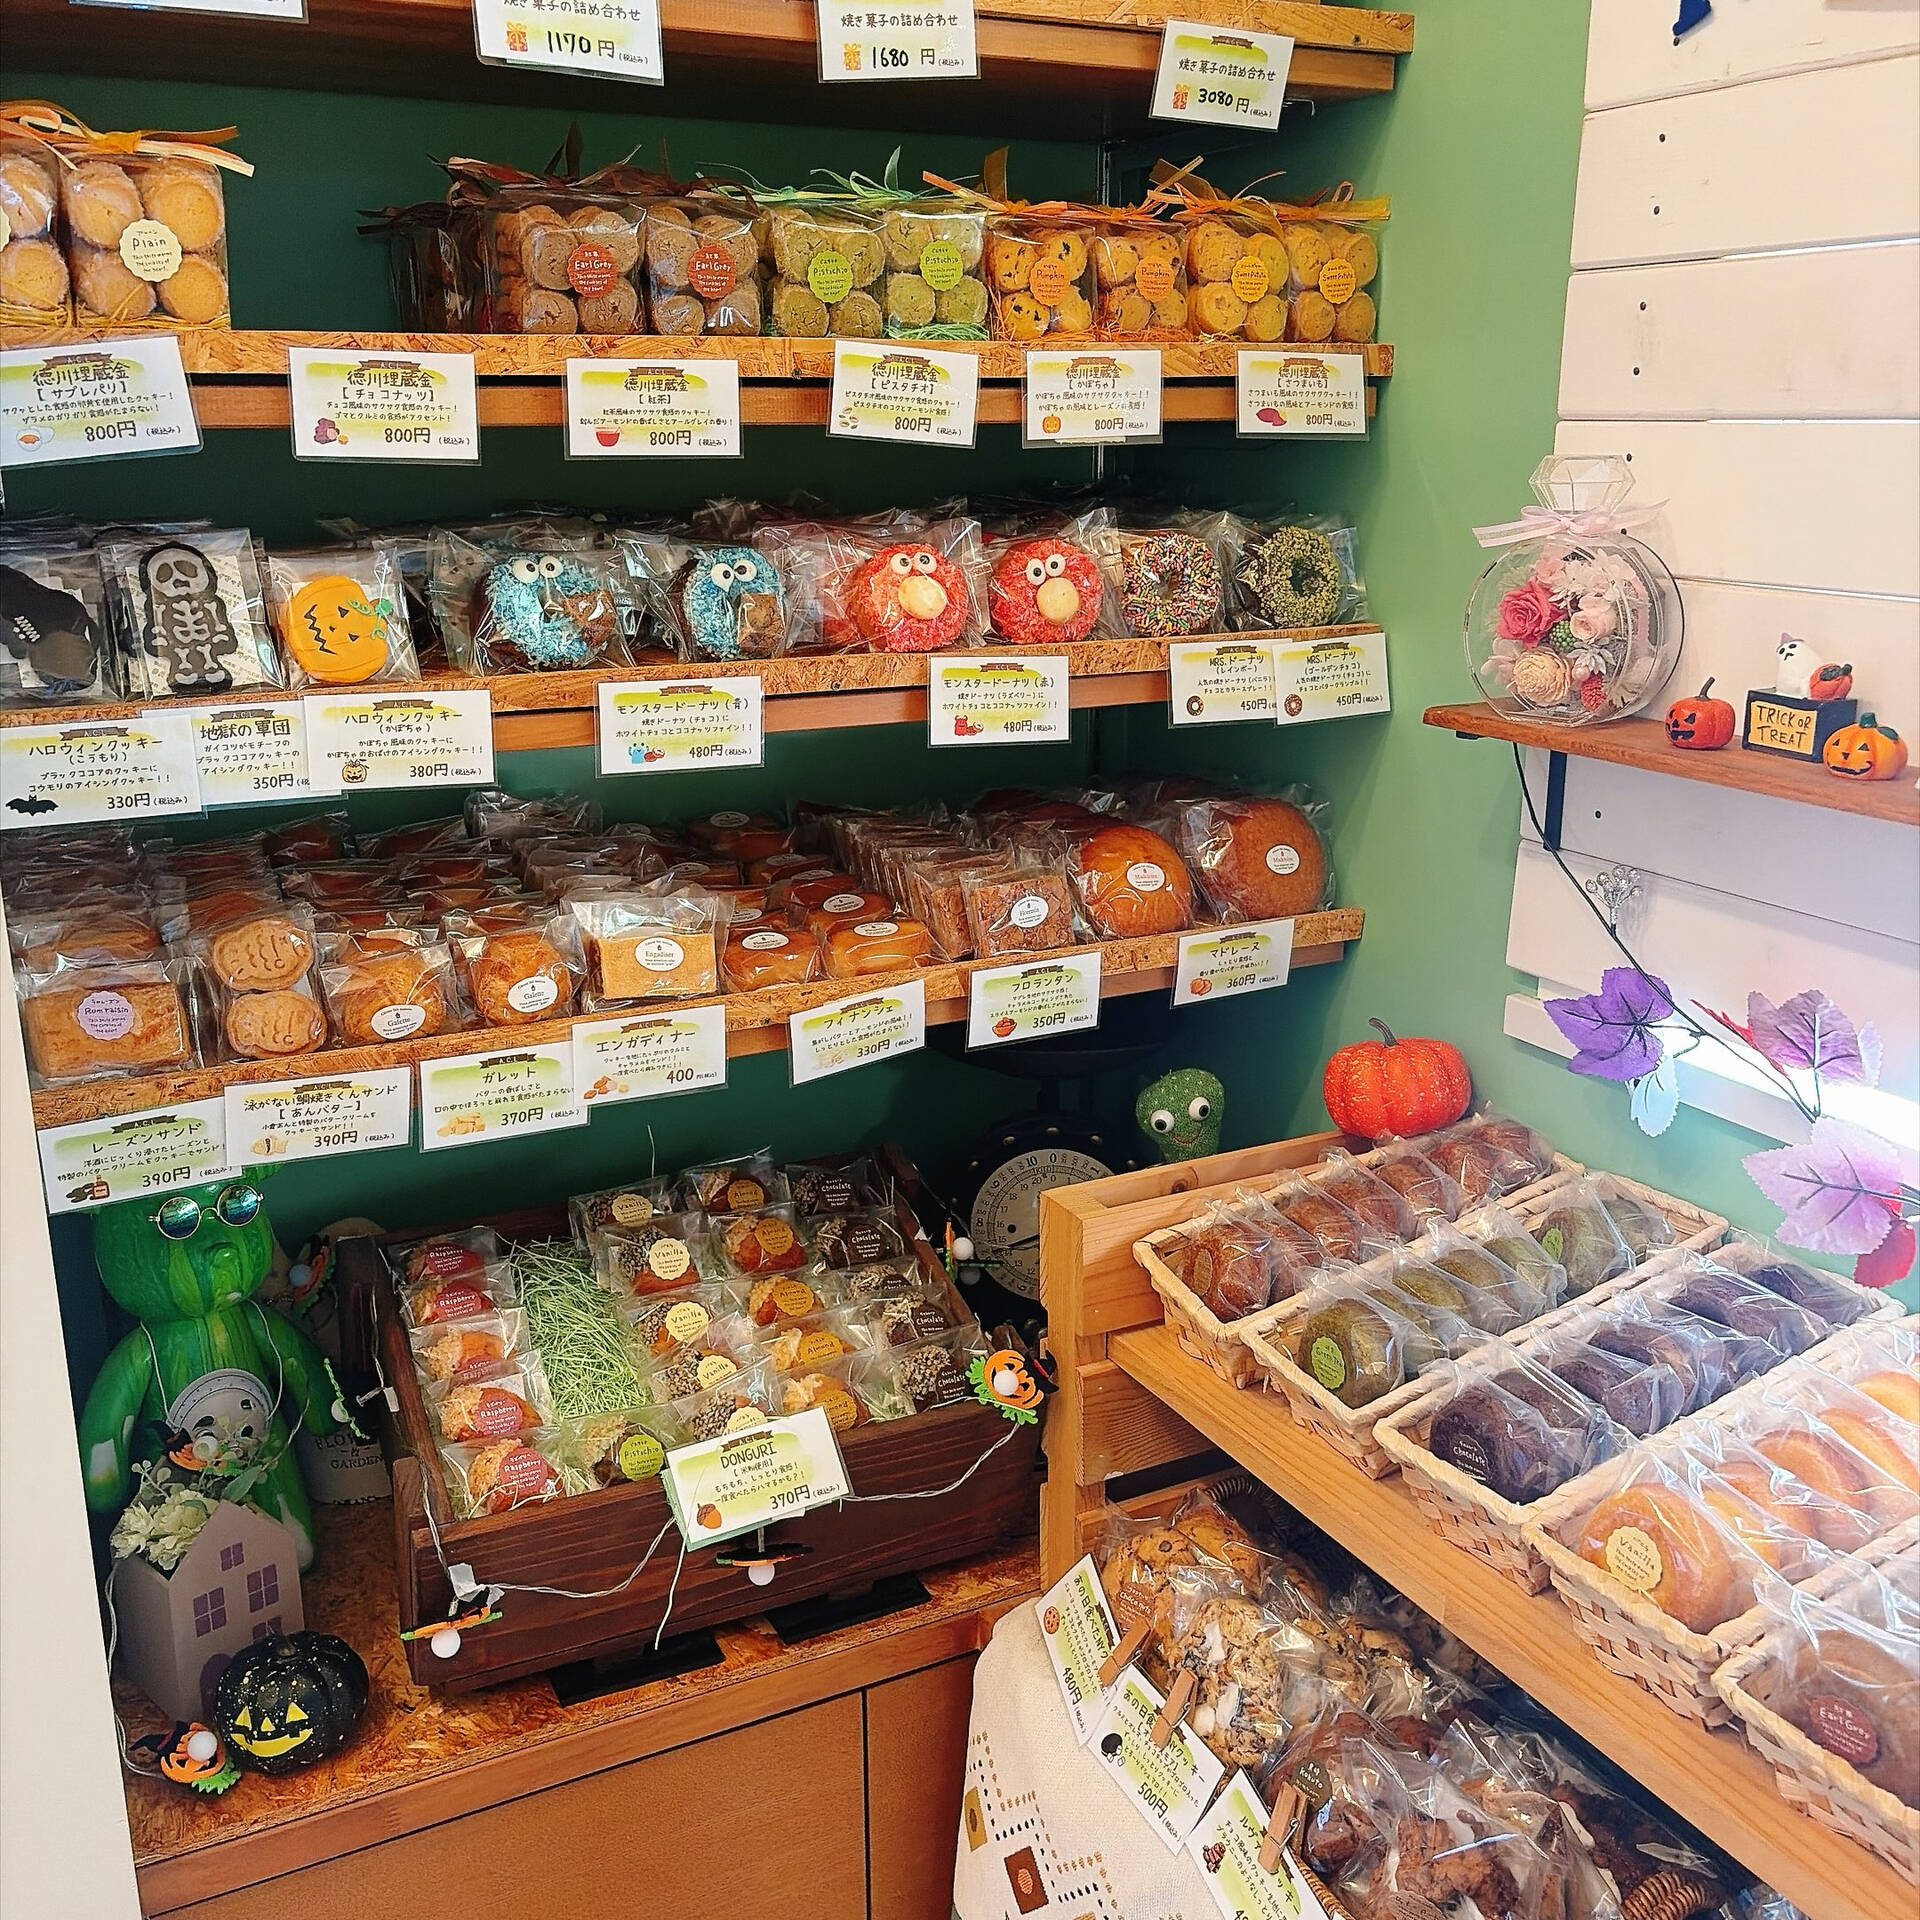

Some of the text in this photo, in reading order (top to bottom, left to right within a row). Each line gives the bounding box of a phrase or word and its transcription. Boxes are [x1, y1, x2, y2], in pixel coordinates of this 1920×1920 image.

[841, 13, 958, 28] 焼き菓子の詰め合わせ
[1179, 58, 1276, 81] 焼き菓子の詰め合わせ
[132, 238, 166, 250] Plain
[575, 261, 612, 270] Earl Grey
[32, 362, 130, 386] 徳川埋蔵金
[348, 370, 434, 388] 徳川埋蔵金
[872, 362, 940, 383] 徳川埋蔵金
[1066, 365, 1122, 379] 徳川埋蔵金
[1279, 367, 1329, 379] 徳川埋蔵金
[625, 378, 690, 392] 徳川埋蔵金
[871, 378, 934, 395] 【ピスタチオ】
[1069, 379, 1115, 389] 【かぼちゃ】
[1278, 380, 1328, 388] 【さつまいも】
[343, 387, 434, 401] 【チョコナッツ】
[639, 395, 671, 404] 【紅茶】
[895, 416, 931, 432] 800円
[1095, 418, 1123, 430] 800円
[1306, 413, 1332, 425] 800円
[84, 420, 180, 442] 800円 （税込み）
[385, 427, 470, 445] 800円 （税込み）
[650, 430, 691, 446] 800円
[944, 677, 1054, 688] モンスタードーナツ（赤）
[617, 698, 749, 715] モンスタードーナツ（青）
[1241, 699, 1267, 710] 450円
[1336, 693, 1361, 706] 450円
[345, 711, 462, 724] ハロウィンクッキー
[1757, 705, 1811, 729] TRICK OR
[200, 719, 291, 741] 地獄の軍団
[1004, 720, 1031, 732] 480円
[358, 737, 453, 747] かぼちゃ風味のクッキーに
[1757, 725, 1806, 749] TREAT
[29, 737, 162, 757] ハロウィンクッキー
[689, 745, 722, 759] 480円
[69, 752, 127, 765] （こうもり）
[40, 765, 158, 781] ブラックココアのクッキーに
[409, 763, 448, 778] 380円
[253, 774, 293, 790] 350円
[107, 793, 188, 809] 330円 （税込み）
[1210, 942, 1260, 958] マドレーヌ
[1012, 975, 1073, 992] フロランタン
[1227, 973, 1255, 988] 360円
[824, 1005, 893, 1029] フィナンシェ
[1032, 1012, 1065, 1029] 350円
[596, 1030, 695, 1053] エンガディナー
[857, 1039, 890, 1058] 330円
[482, 1066, 536, 1084] ガレット
[244, 1085, 398, 1112] 泳がない鯛焼きくんサンド
[279, 1101, 361, 1120] 【あんバター】
[501, 1107, 543, 1126] 370円
[93, 1122, 202, 1154] レーズンサンド
[314, 1130, 358, 1148] 390円
[142, 1166, 191, 1188] 390円
[655, 1249, 683, 1259] Vanilla
[671, 1311, 702, 1324] Vanilla
[479, 1405, 518, 1419] Raspberry
[720, 1441, 778, 1469] DONGURI
[504, 1459, 542, 1473] Raspberry
[770, 1484, 810, 1510] 370円
[1620, 1536, 1655, 1570] Vanilla
[1062, 1666, 1083, 1705] 480円
[1299, 1768, 1323, 1789] Kokuto
[1137, 1782, 1169, 1819] 500円
